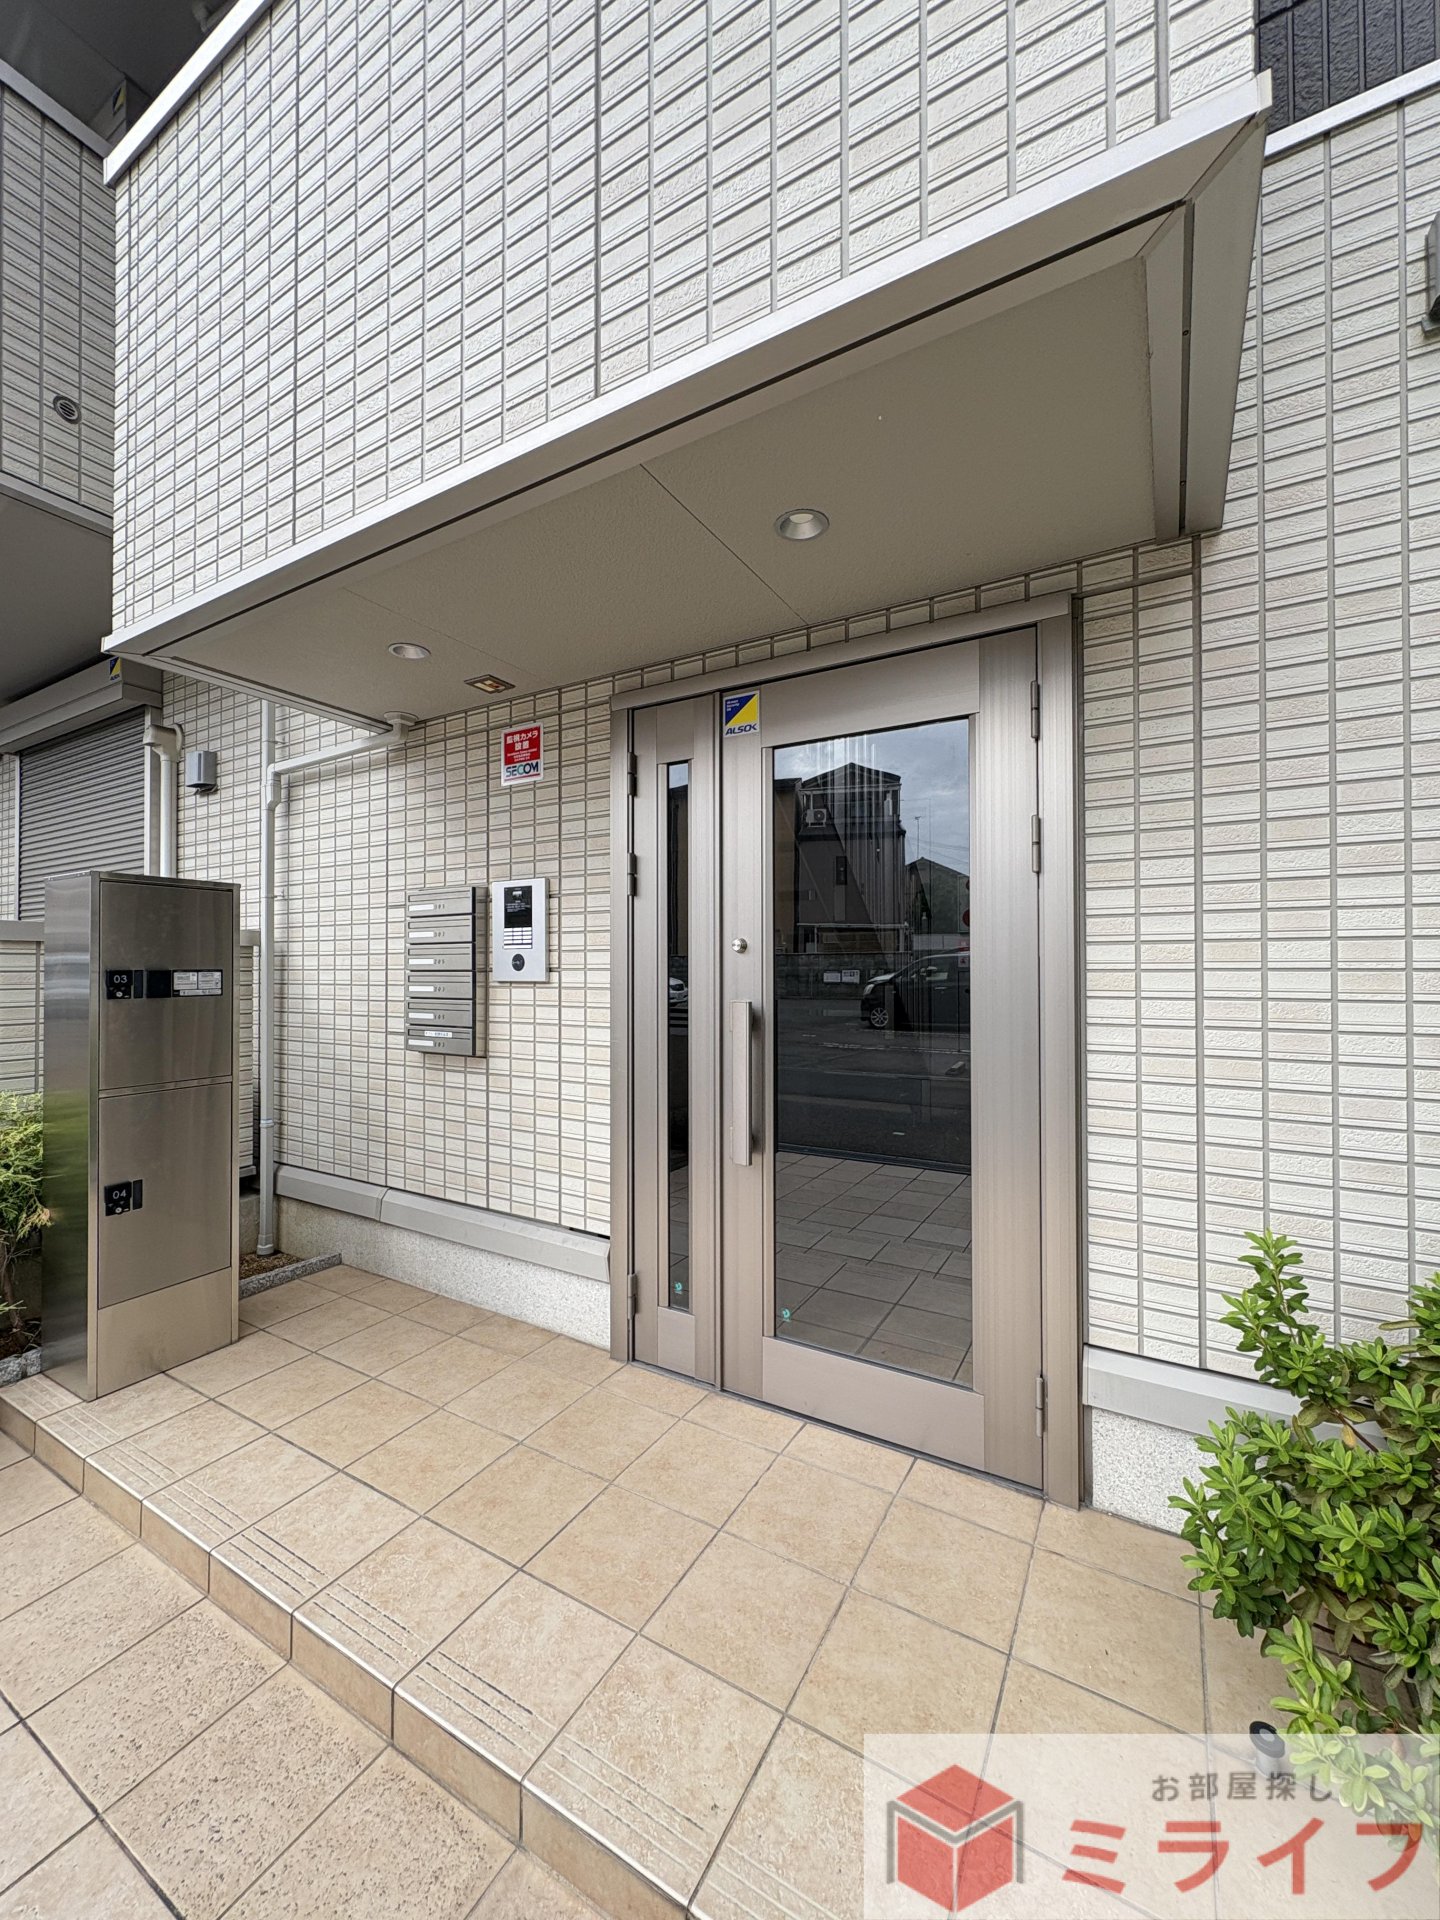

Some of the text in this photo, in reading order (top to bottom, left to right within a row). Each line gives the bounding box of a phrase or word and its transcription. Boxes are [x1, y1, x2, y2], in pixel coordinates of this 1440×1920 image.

[725, 723, 757, 736] ALSOK
[505, 761, 540, 778] SECOM
[113, 974, 128, 984] 03
[112, 1189, 127, 1200] 04
